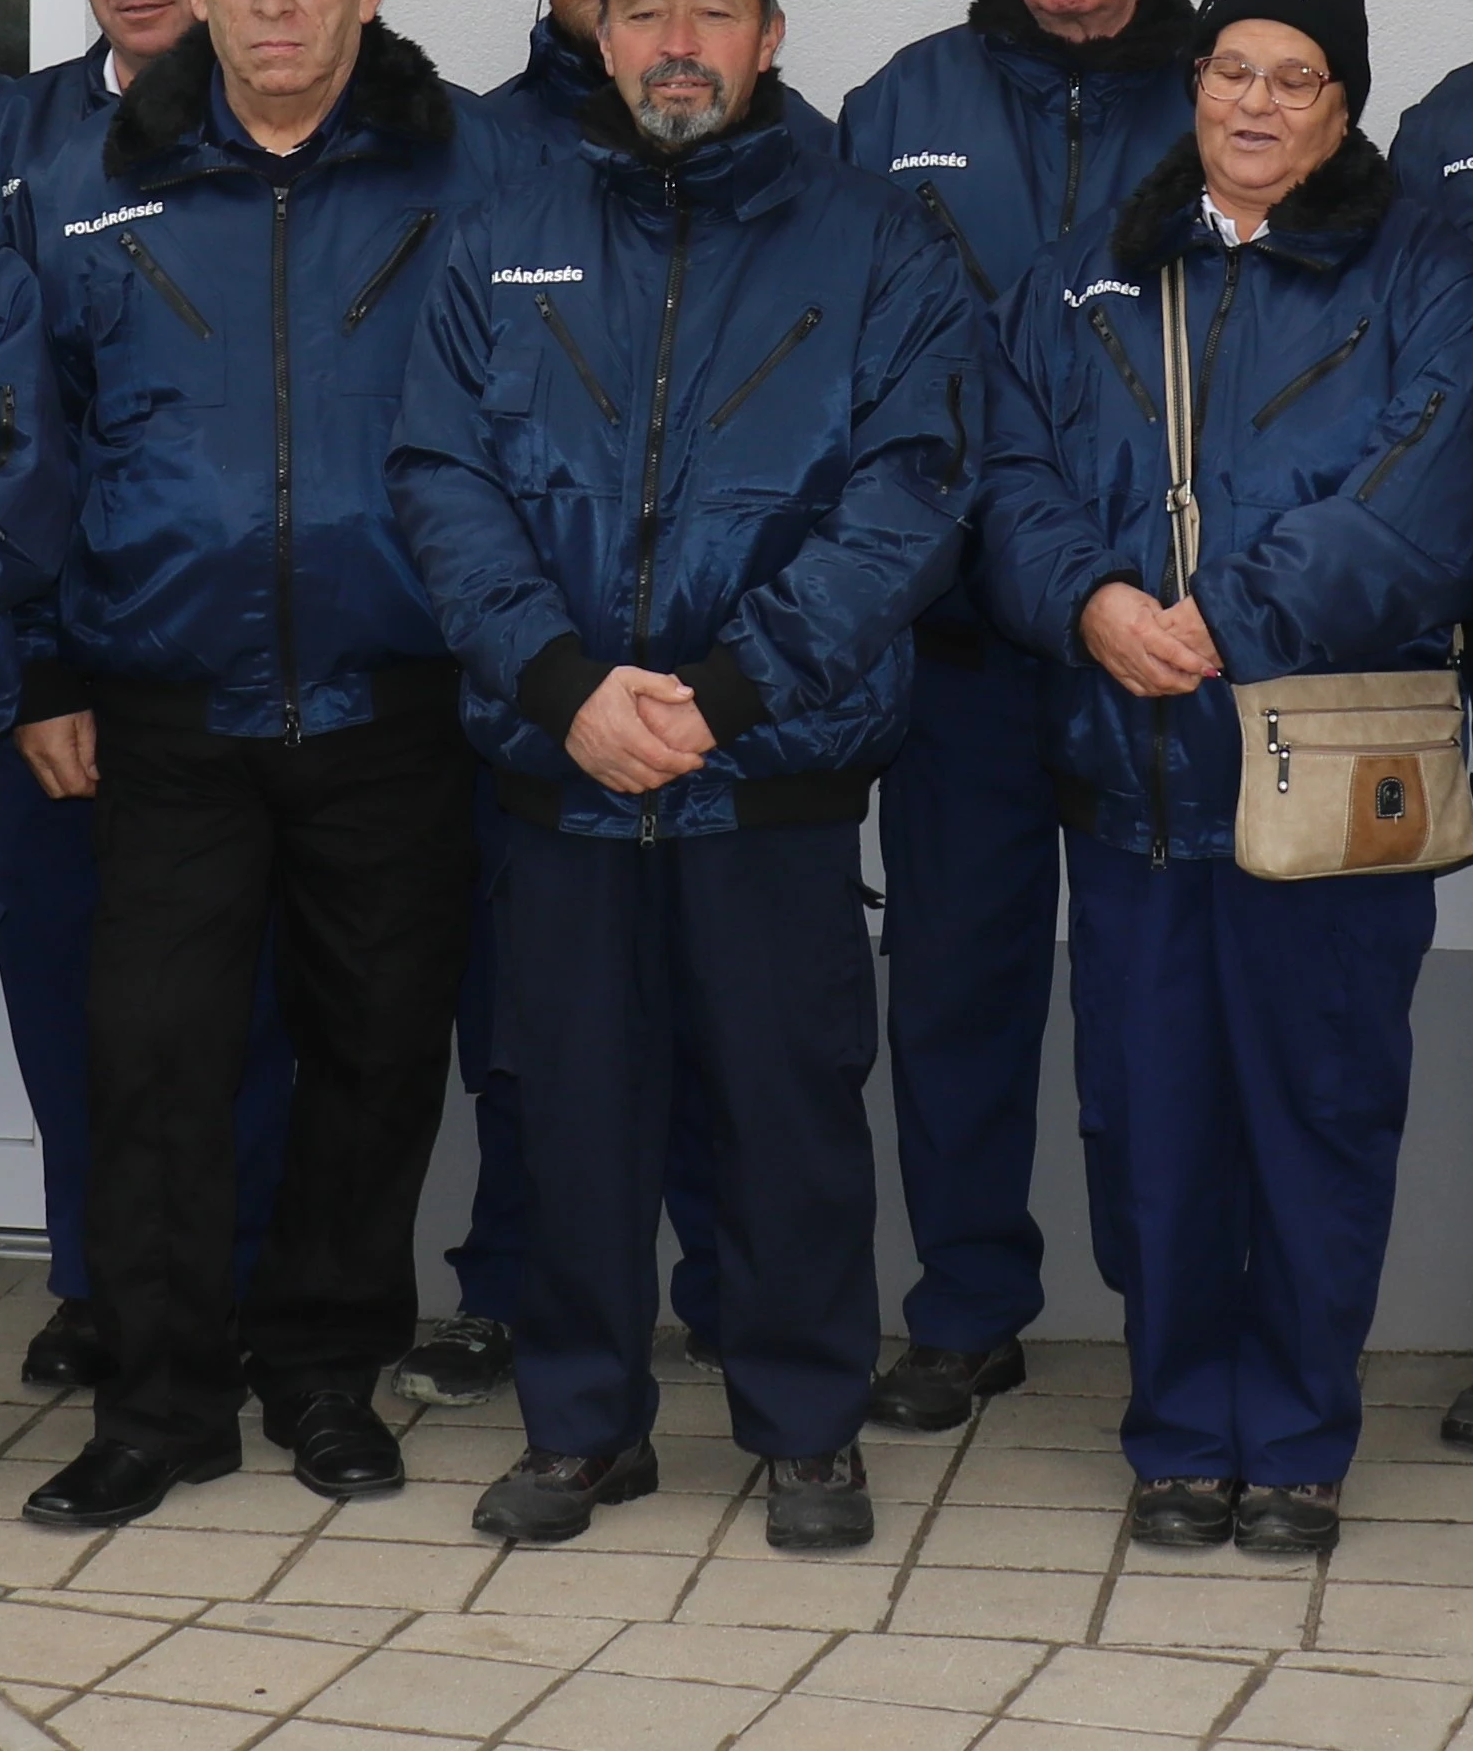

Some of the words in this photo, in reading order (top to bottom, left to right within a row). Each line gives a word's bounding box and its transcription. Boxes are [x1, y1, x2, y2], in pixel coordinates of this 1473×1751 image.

[889, 151, 967, 173] GÁRŐRSÉG
[64, 201, 164, 237] POLGÁRŐRSÉG
[492, 265, 583, 285] LGÁRŐRSÉG
